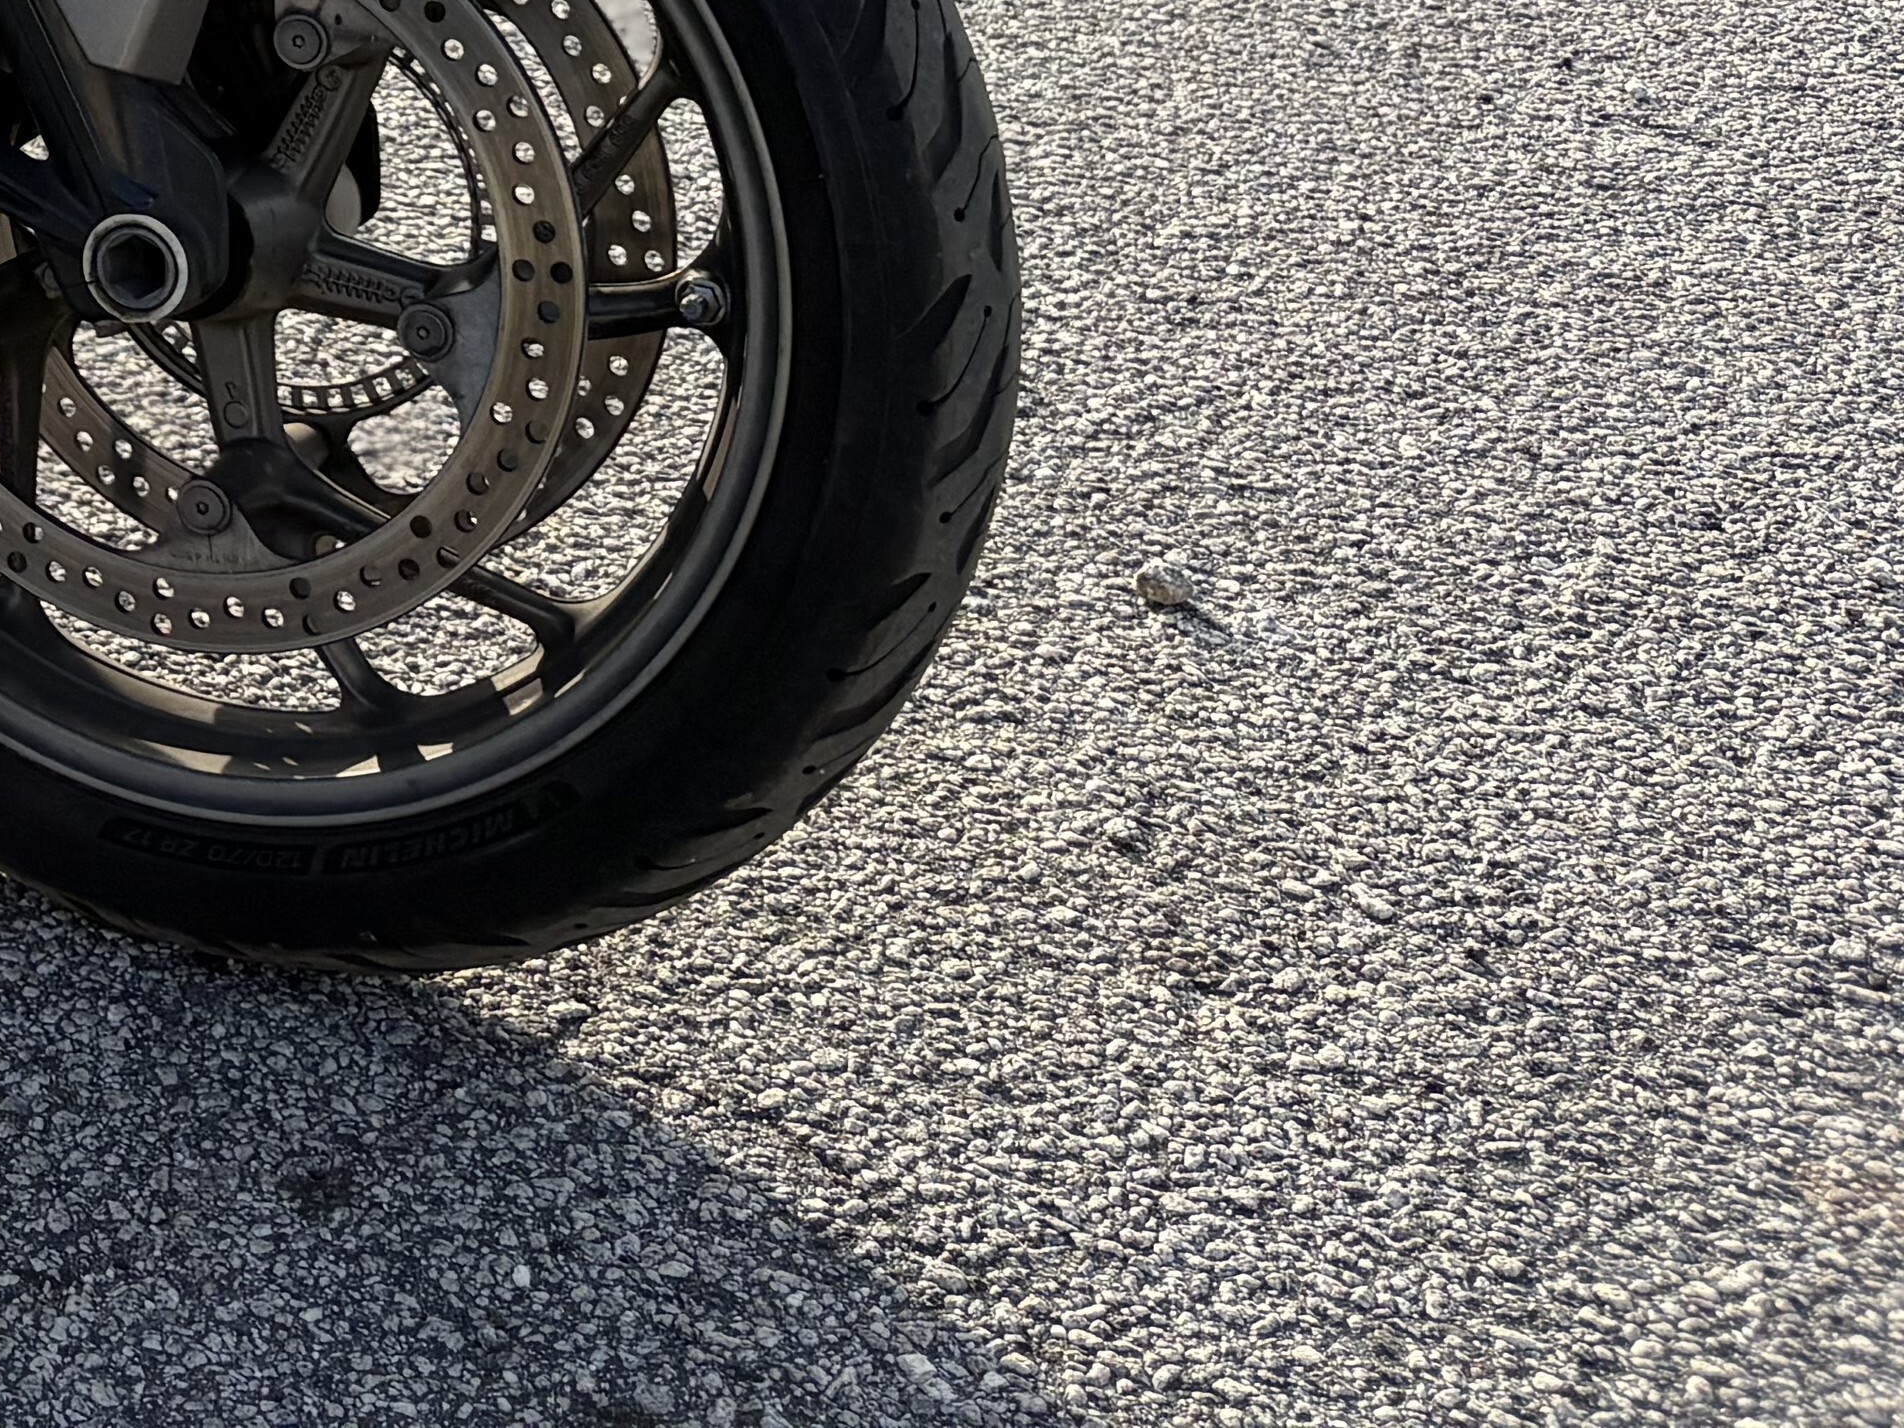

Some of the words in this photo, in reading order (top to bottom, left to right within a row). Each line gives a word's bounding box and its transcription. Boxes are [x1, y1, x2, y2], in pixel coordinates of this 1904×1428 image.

[157, 835, 195, 859] ZR
[340, 810, 513, 869] MICHELIN
[206, 844, 303, 871] 120/70
